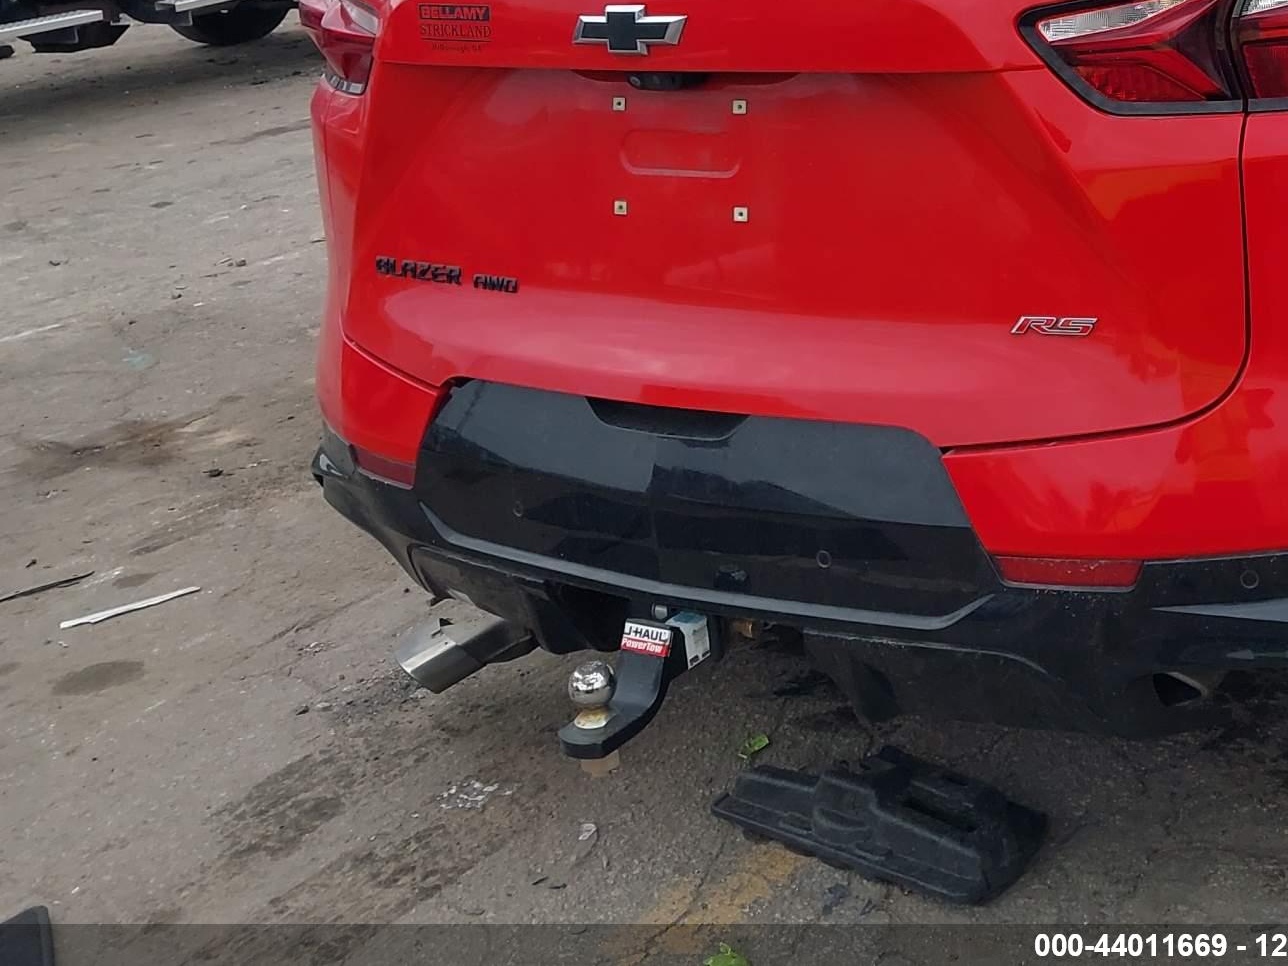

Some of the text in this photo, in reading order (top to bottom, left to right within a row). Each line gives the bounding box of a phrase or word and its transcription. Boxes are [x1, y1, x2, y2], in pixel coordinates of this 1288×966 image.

[420, 5, 487, 21] BELLAMY
[421, 23, 492, 38] STRICKLAND
[376, 255, 519, 294] BLAZER AWD
[1010, 315, 1099, 336] RS
